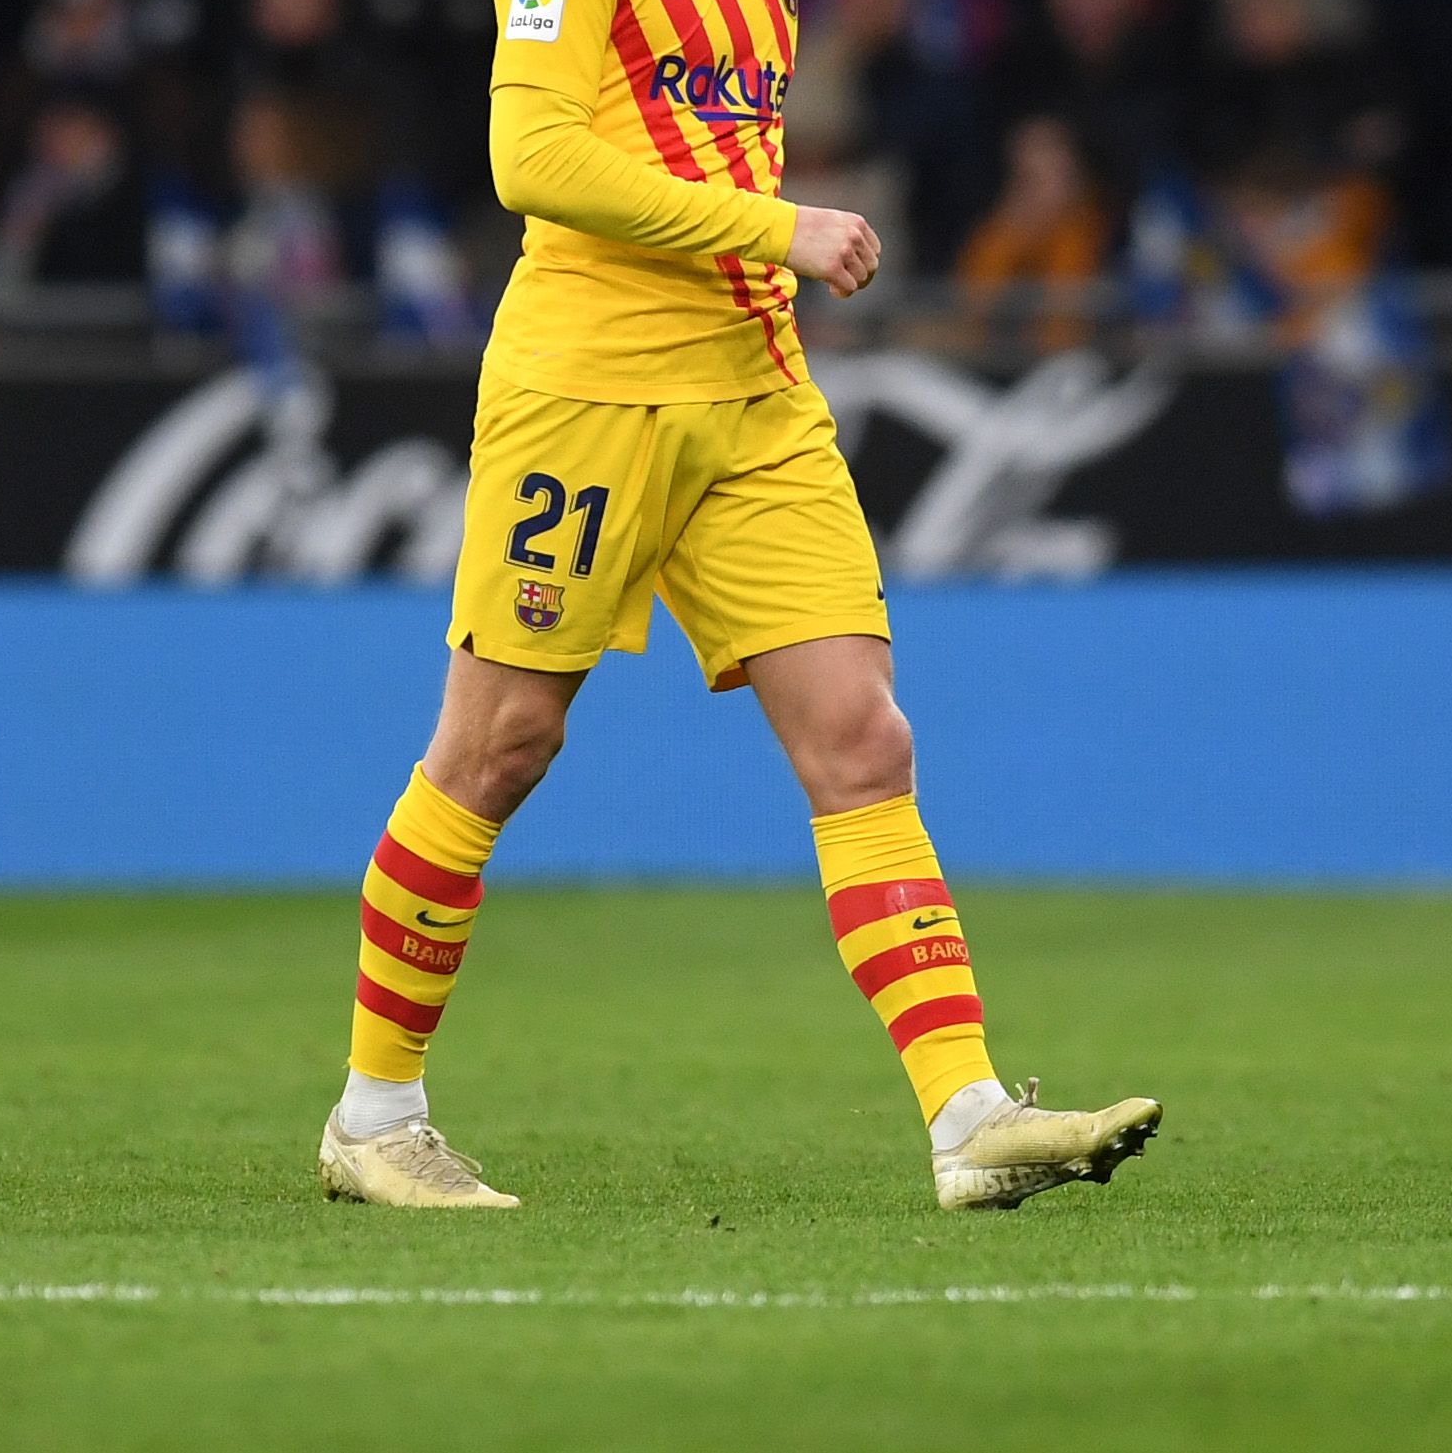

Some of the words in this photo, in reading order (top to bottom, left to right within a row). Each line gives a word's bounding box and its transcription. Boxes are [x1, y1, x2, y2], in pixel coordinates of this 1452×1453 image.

[510, 14, 554, 29] LaLiga
[503, 471, 610, 580] 21
[911, 941, 970, 964] BARÇ
